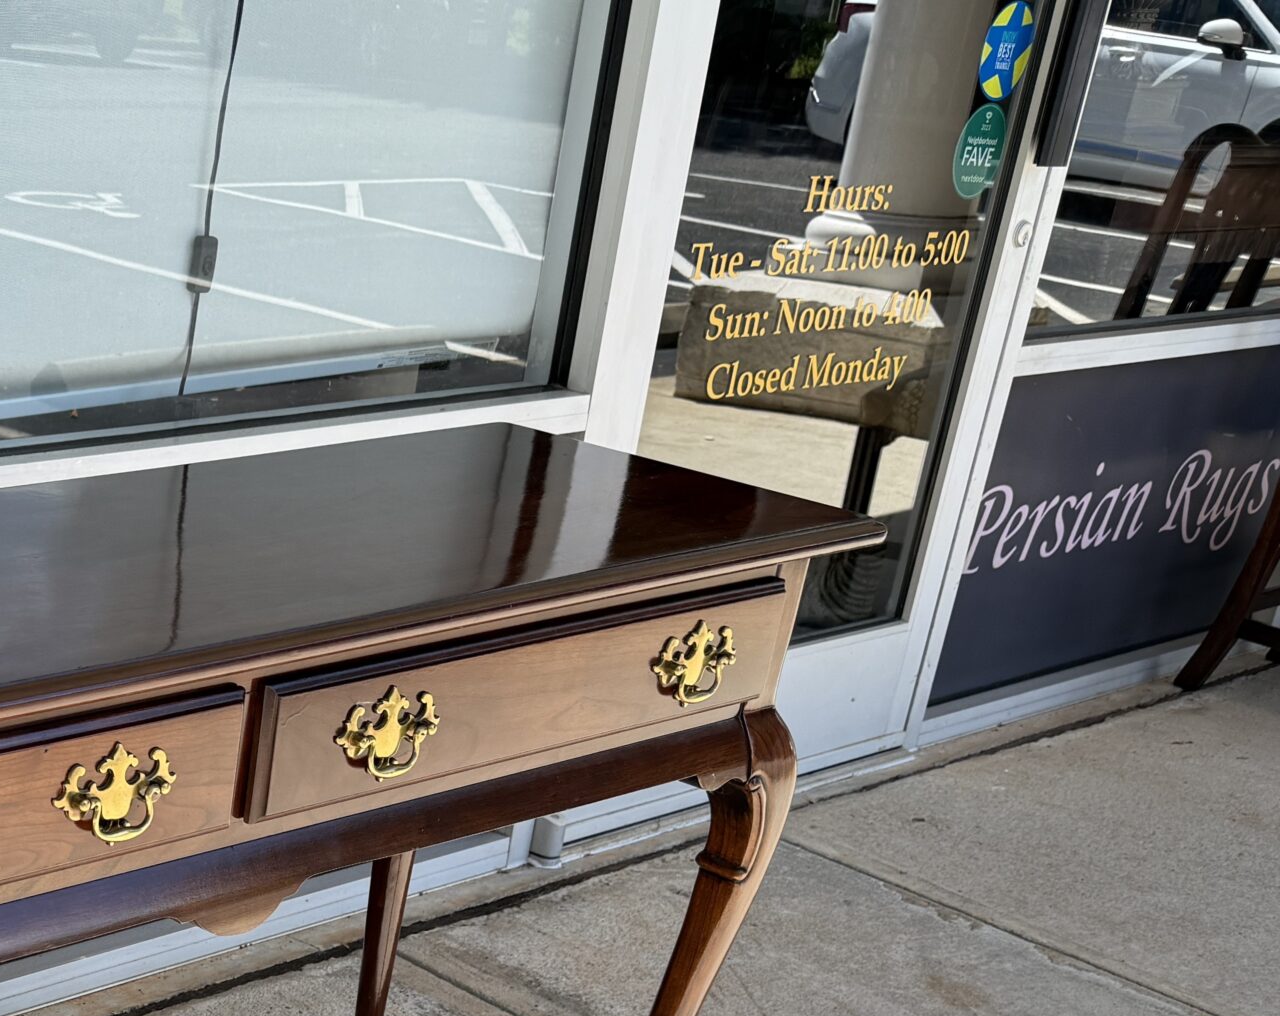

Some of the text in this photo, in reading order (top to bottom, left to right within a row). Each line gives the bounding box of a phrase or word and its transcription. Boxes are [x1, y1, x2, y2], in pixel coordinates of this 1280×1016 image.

[998, 43, 1016, 58] BEST
[961, 146, 995, 167] FAVE
[967, 136, 998, 146] Neighborhood
[803, 175, 894, 213] Hours:
[960, 174, 985, 183] nextdoor
[690, 230, 970, 281] Tue - Sat: 11:00 to 5:00
[705, 303, 770, 341] Sun:
[773, 298, 846, 335] Noon
[852, 296, 878, 328] to
[706, 346, 908, 400] Closed Monday
[961, 449, 1280, 575] Persian Rugs
